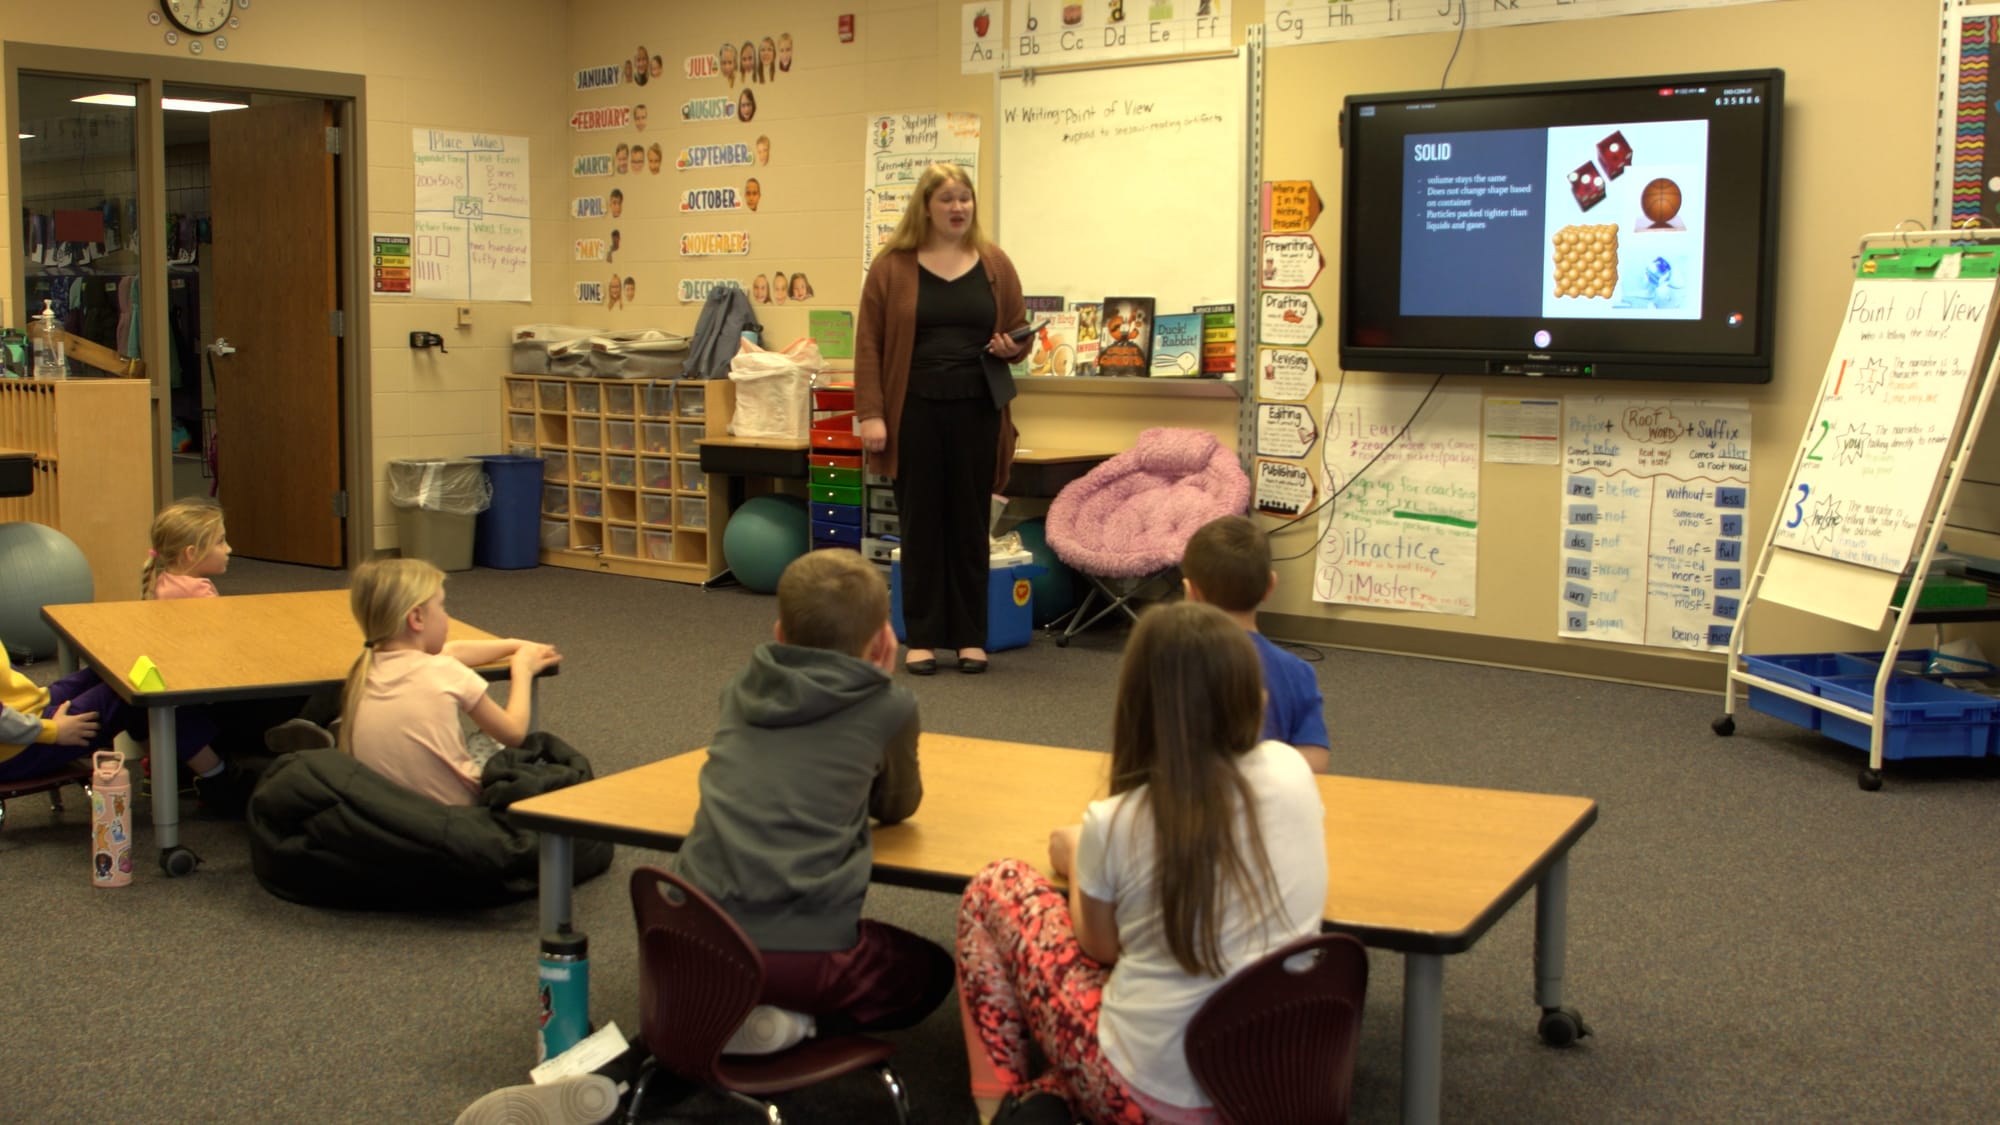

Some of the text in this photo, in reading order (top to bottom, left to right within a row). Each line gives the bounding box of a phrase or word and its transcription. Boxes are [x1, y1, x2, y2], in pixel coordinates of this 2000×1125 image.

[196, 20, 202, 30] 6
[1276, 11, 1303, 39] Gg
[1328, 7, 1353, 27] Hh
[1104, 27, 1126, 47] Dd
[1150, 22, 1170, 43] Ee
[1196, 17, 1218, 39] Ff
[1020, 36, 1040, 56] Bb
[1060, 31, 1083, 50] Cc
[970, 43, 992, 61] Aa
[688, 56, 714, 78] JULY
[577, 66, 620, 89] JANUARY
[688, 98, 727, 119] AUGUST
[1104, 100, 1118, 118] of
[1124, 100, 1155, 116] View
[577, 108, 626, 130] FEBRUARY
[433, 131, 498, 150] Place Value
[688, 145, 748, 166] SEPTEMBER
[1414, 142, 1452, 161] SOLID
[578, 158, 608, 176] MARCH
[1427, 176, 1454, 184] volume
[1455, 176, 1472, 186] stays
[1474, 174, 1486, 182] the
[688, 188, 736, 210] OCTOBER
[1427, 184, 1532, 197] Does not change shape based
[458, 203, 481, 216] 258
[577, 199, 603, 217] APRIL
[1437, 199, 1472, 207] container
[1426, 207, 1528, 220] Particles packed tighter than
[1426, 220, 1486, 232] liquids and gases
[488, 240, 528, 254] hundred
[580, 242, 600, 258] MAY
[686, 234, 742, 254] NOVEMBER
[1264, 239, 1314, 258] Prewriting
[578, 284, 601, 302] JUNE
[1266, 295, 1308, 316] Drafting
[1848, 289, 1985, 324] Point of View
[1158, 320, 1188, 335] Duck!
[1162, 334, 1198, 347] Rabbit!
[1272, 350, 1308, 372] Revising
[1268, 407, 1302, 427] Editing
[1350, 406, 1412, 441] iLearn
[1698, 418, 1740, 438] Suffix
[1689, 444, 1748, 460] Comes after
[1844, 436, 1862, 455] you
[1262, 464, 1306, 487] Publishing
[1707, 462, 1726, 471] root
[1402, 476, 1418, 494] for
[1572, 478, 1640, 498] pre before
[1666, 488, 1740, 506] without less
[1575, 511, 1593, 522] non
[1722, 522, 1736, 532] er
[1346, 527, 1445, 566] iPractice
[1570, 536, 1586, 548] dis
[1666, 539, 1735, 558] full of ful
[1568, 564, 1588, 576] mis
[1671, 571, 1701, 582] more
[1350, 573, 1420, 600] iMaster
[1569, 591, 1584, 602] un
[1568, 616, 1582, 628] re
[1672, 626, 1700, 647] being
